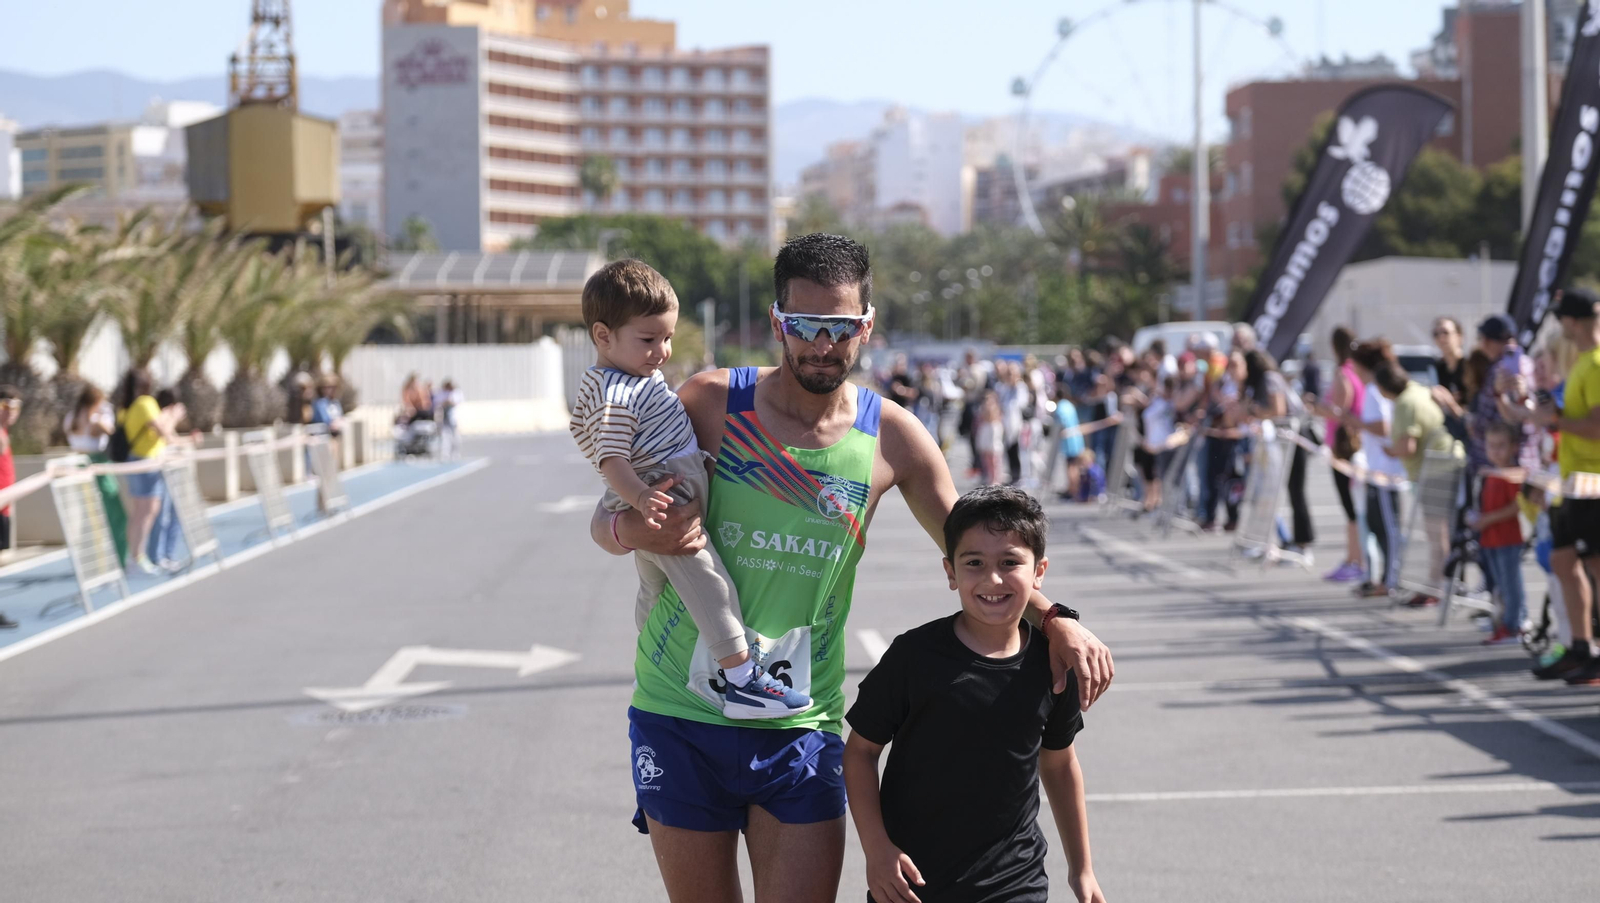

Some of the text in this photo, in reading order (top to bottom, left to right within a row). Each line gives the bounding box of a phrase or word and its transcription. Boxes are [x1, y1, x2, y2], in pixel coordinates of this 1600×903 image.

[1252, 199, 1341, 350] acamos
[750, 530, 844, 562] SAKATA
[786, 563, 796, 573] in
[798, 565, 823, 579] Seed
